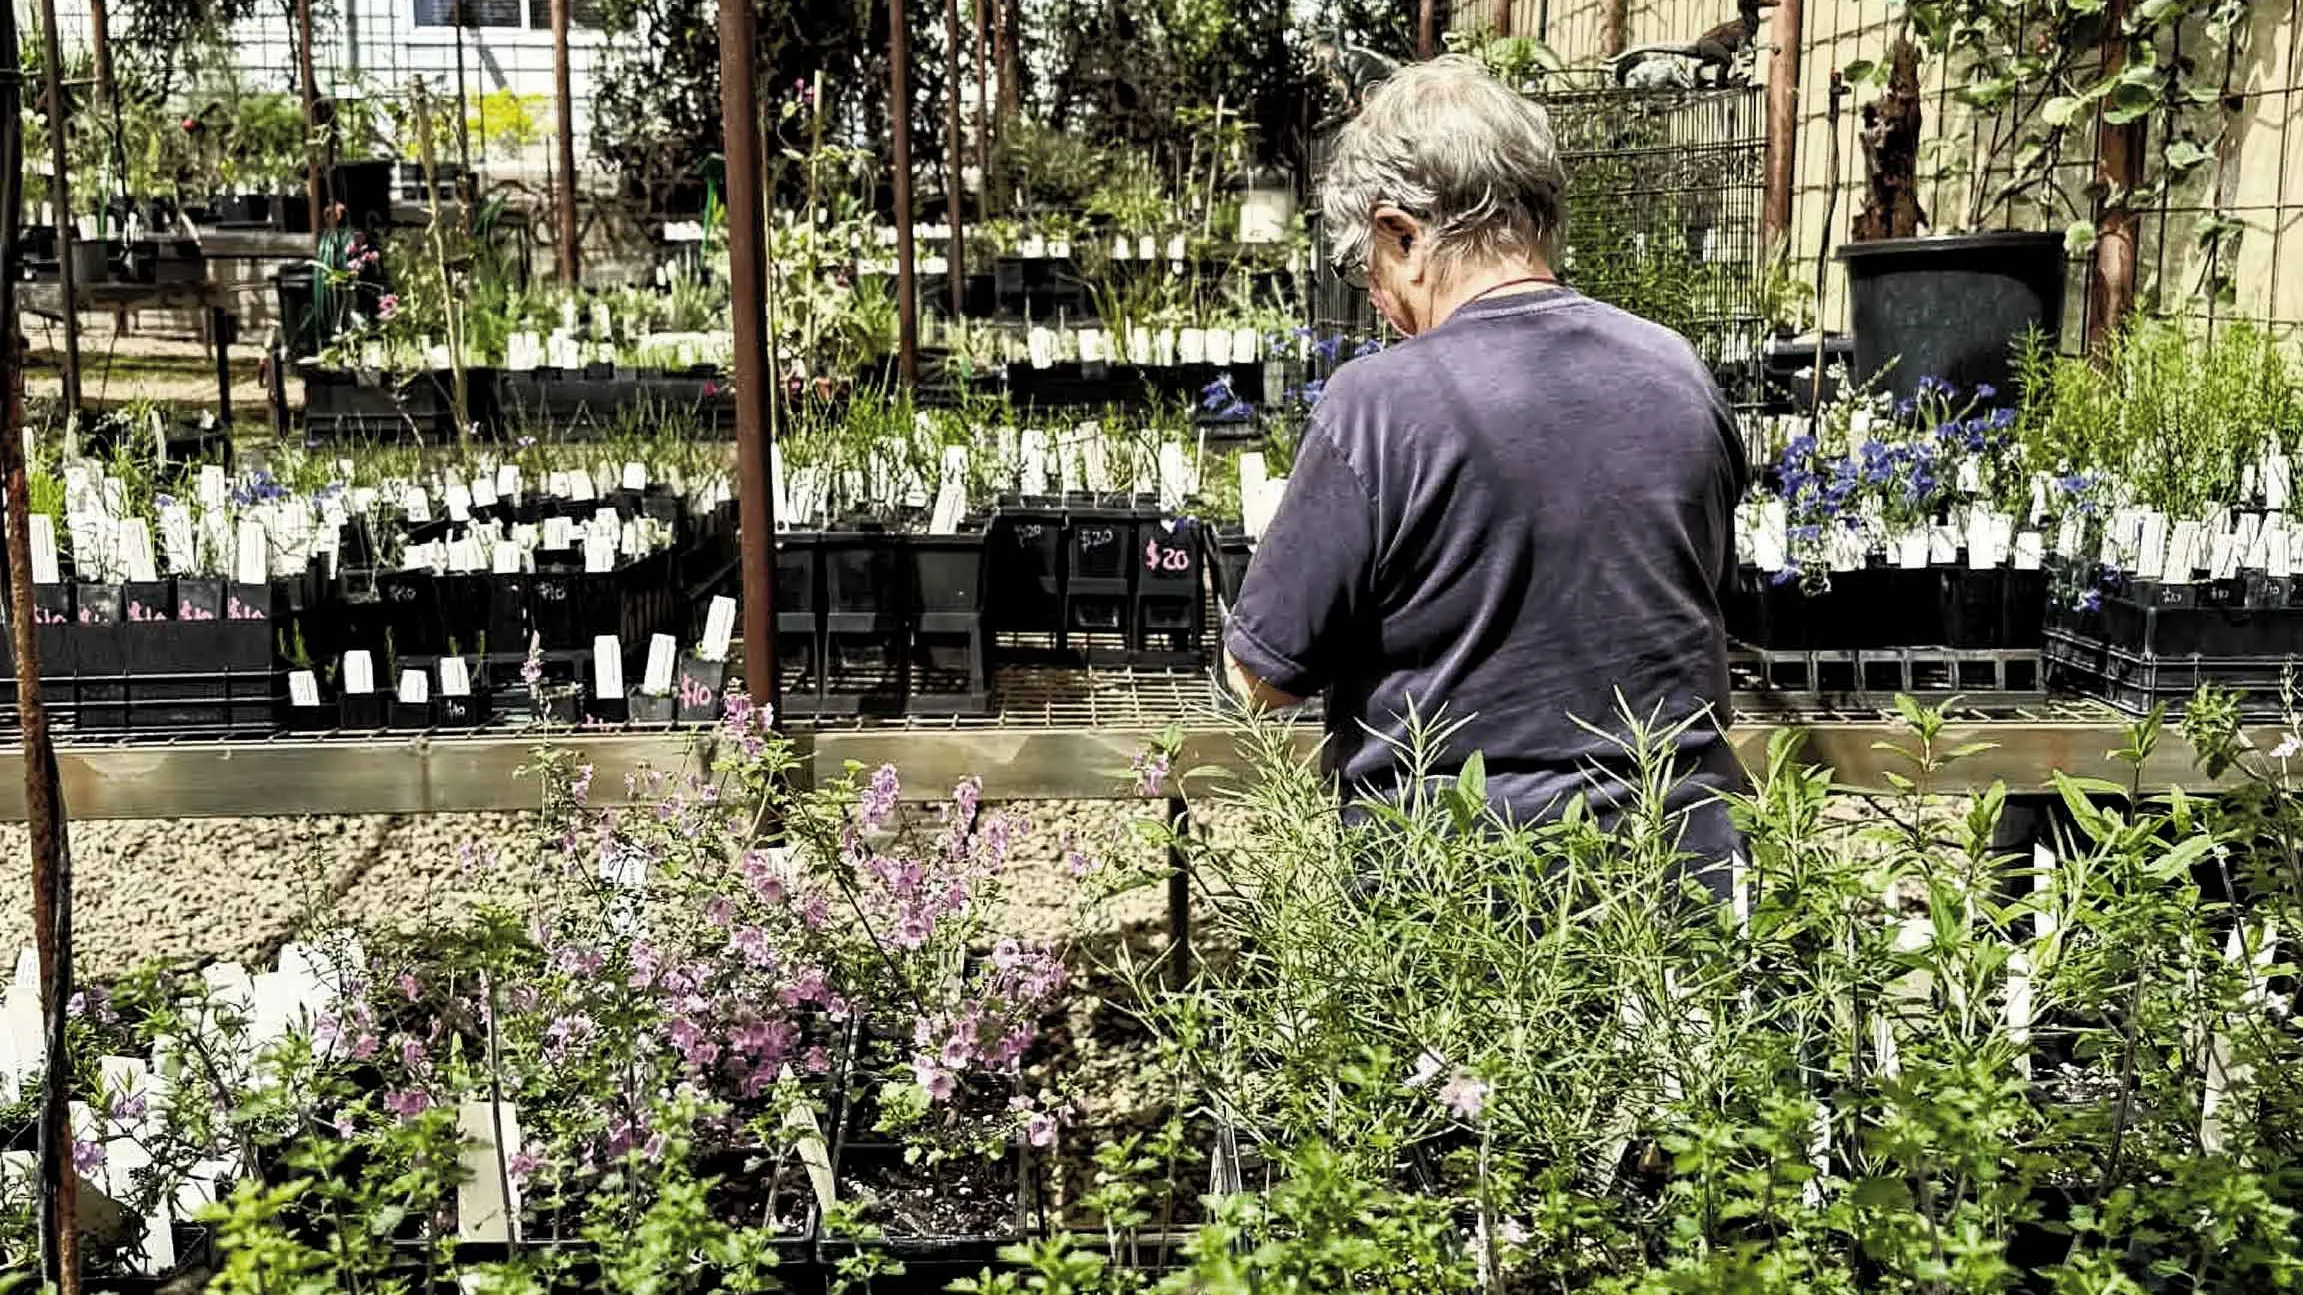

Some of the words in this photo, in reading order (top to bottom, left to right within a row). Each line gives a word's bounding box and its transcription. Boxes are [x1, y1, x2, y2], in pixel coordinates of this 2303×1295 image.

[1079, 528, 1114, 552] $20
[1146, 536, 1189, 571] $20
[679, 672, 713, 711] $10
